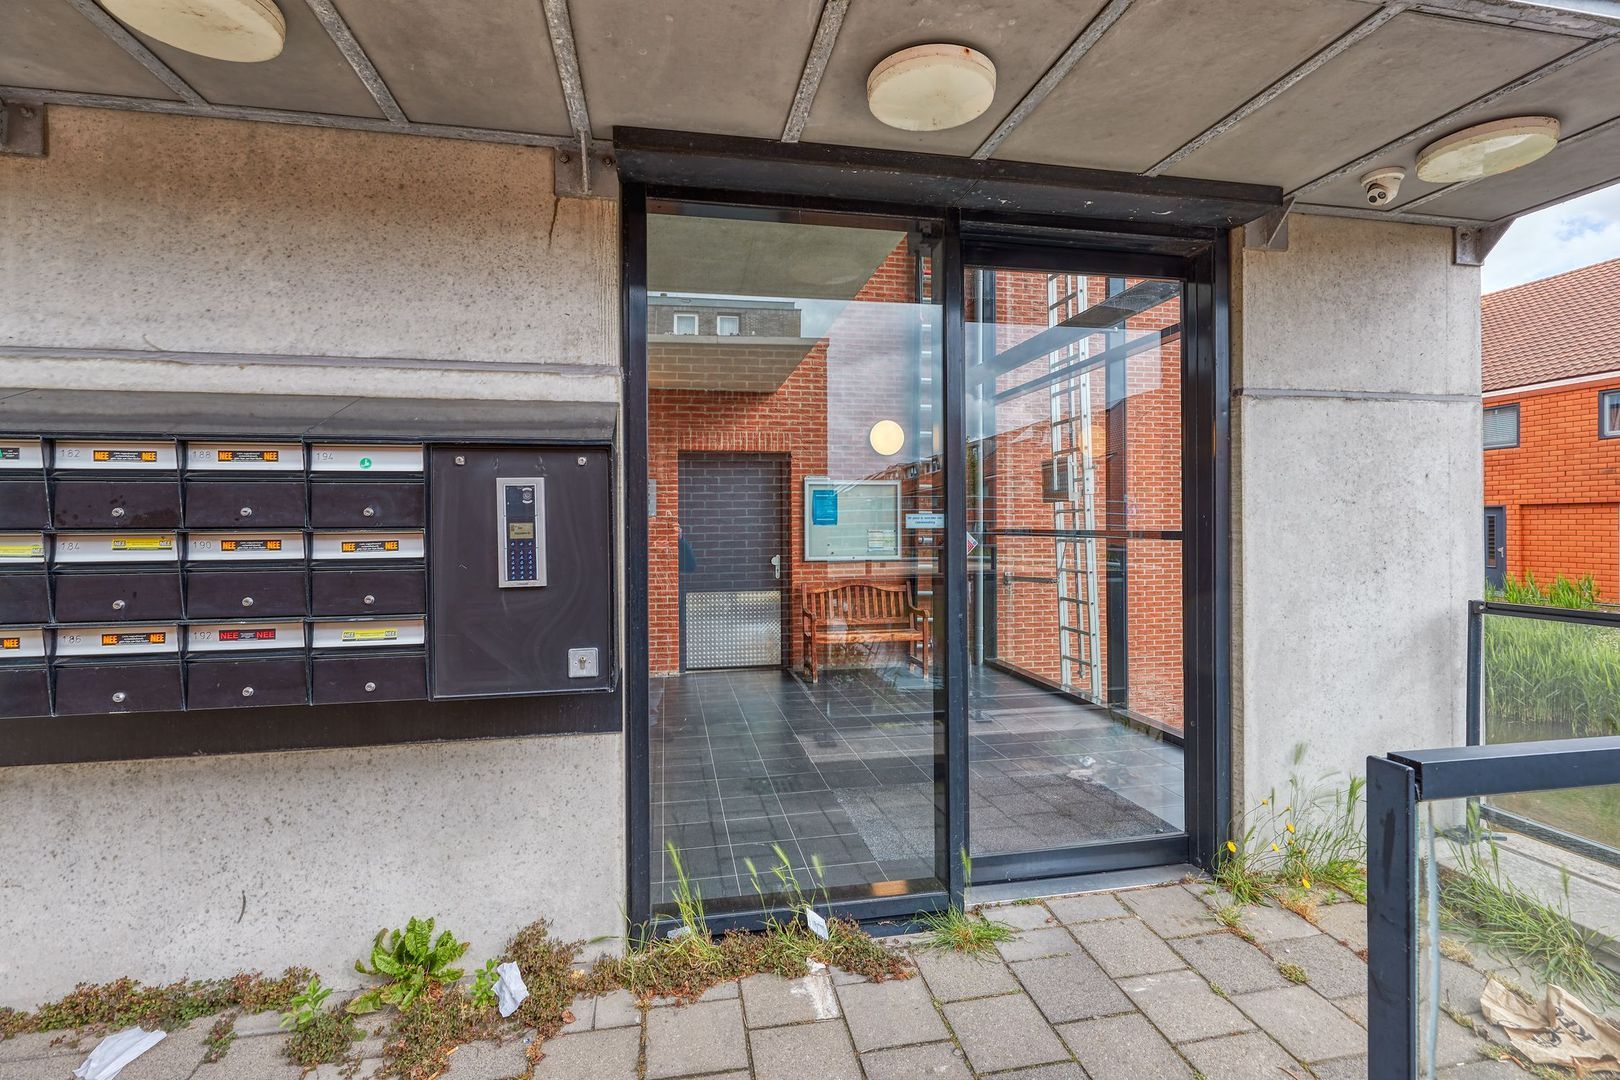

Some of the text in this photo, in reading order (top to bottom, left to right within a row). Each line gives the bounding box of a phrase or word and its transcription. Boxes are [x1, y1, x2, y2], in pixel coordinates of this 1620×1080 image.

[94, 451, 109, 460] NEE
[142, 452, 156, 461] NEE
[192, 450, 211, 459] 188
[219, 452, 233, 460] NEE
[263, 452, 278, 460] NEE
[316, 452, 334, 461] 194
[61, 542, 80, 551] 184
[192, 541, 211, 549] 190
[222, 541, 236, 550] NEE
[267, 541, 281, 549] NEE
[343, 543, 356, 551] NEE
[385, 542, 398, 550] NEE
[62, 635, 82, 644] 186
[103, 635, 118, 644] NEE
[150, 634, 165, 643] NEE
[193, 631, 212, 640] 192
[3, 639, 19, 648] NEE
